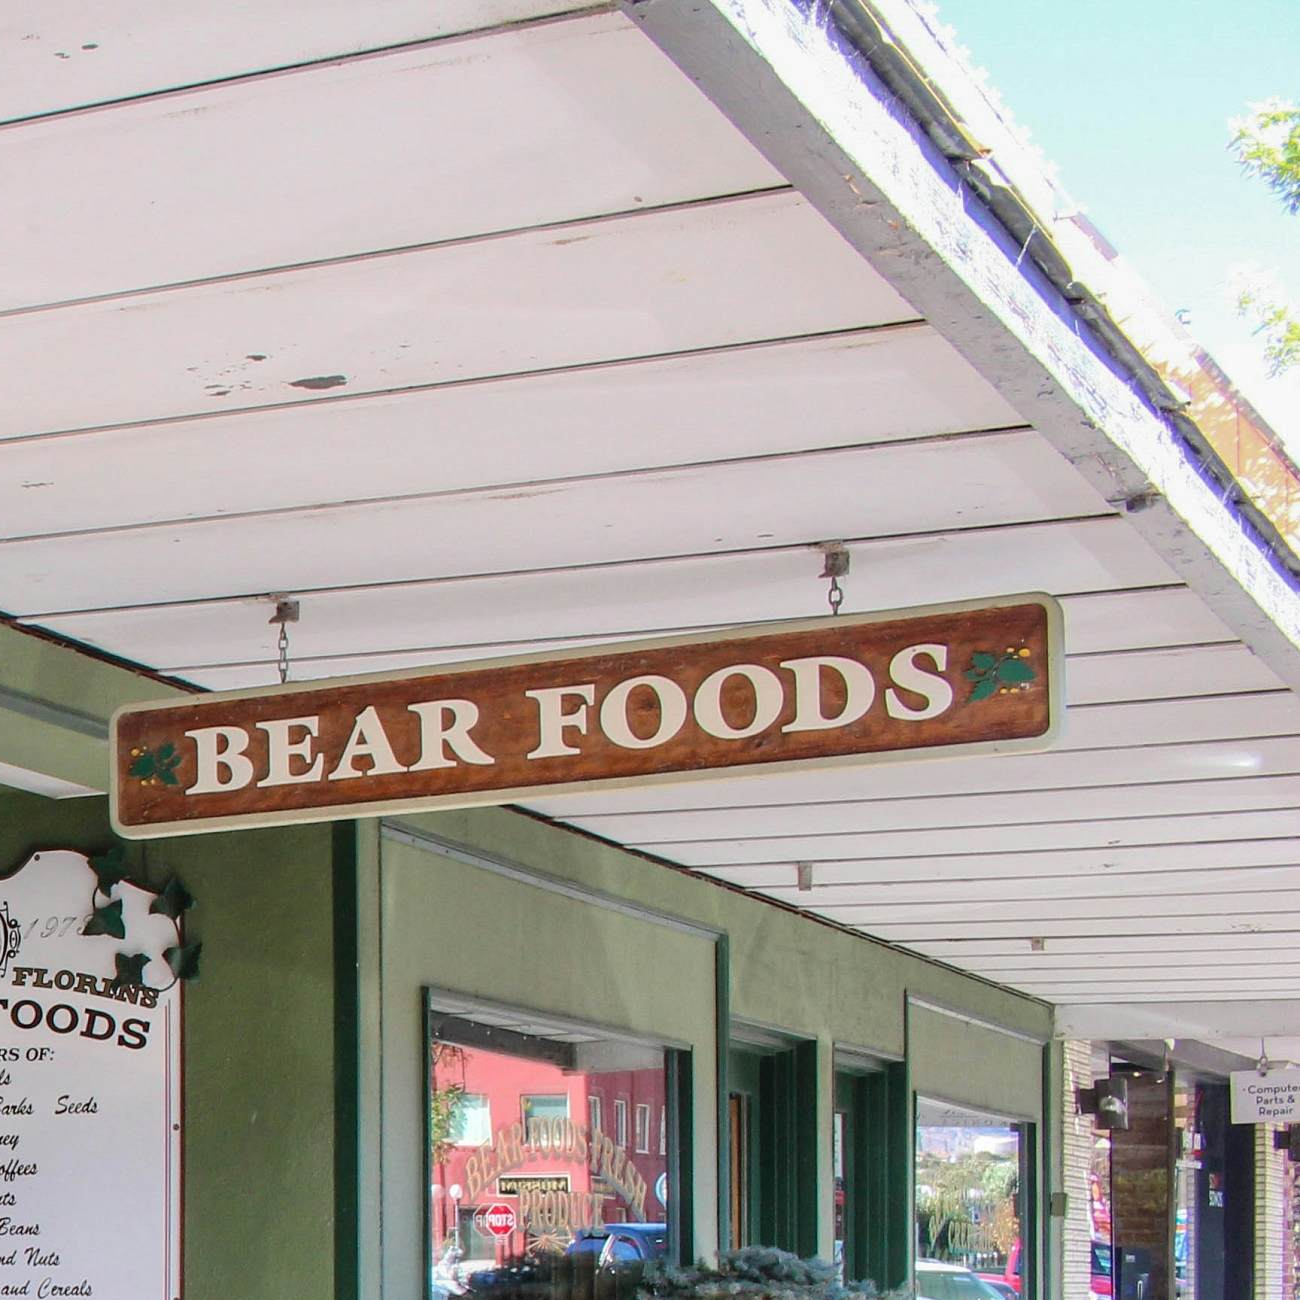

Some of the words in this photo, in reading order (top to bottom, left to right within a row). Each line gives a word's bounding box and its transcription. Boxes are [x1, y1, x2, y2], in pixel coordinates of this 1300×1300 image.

[185, 698, 495, 796] BEAR
[525, 643, 954, 761] FOODS
[12, 967, 159, 1009] FLORINS
[25, 1048, 55, 1063] OF:
[53, 1094, 99, 1116] Seeds
[1256, 1096, 1284, 1105] Parts
[1287, 1094, 1295, 1103] &
[1259, 1106, 1293, 1117] Repair
[23, 1246, 61, 1268] Nuts
[0, 1279, 31, 1297] and
[36, 1276, 93, 1300] Cereals
